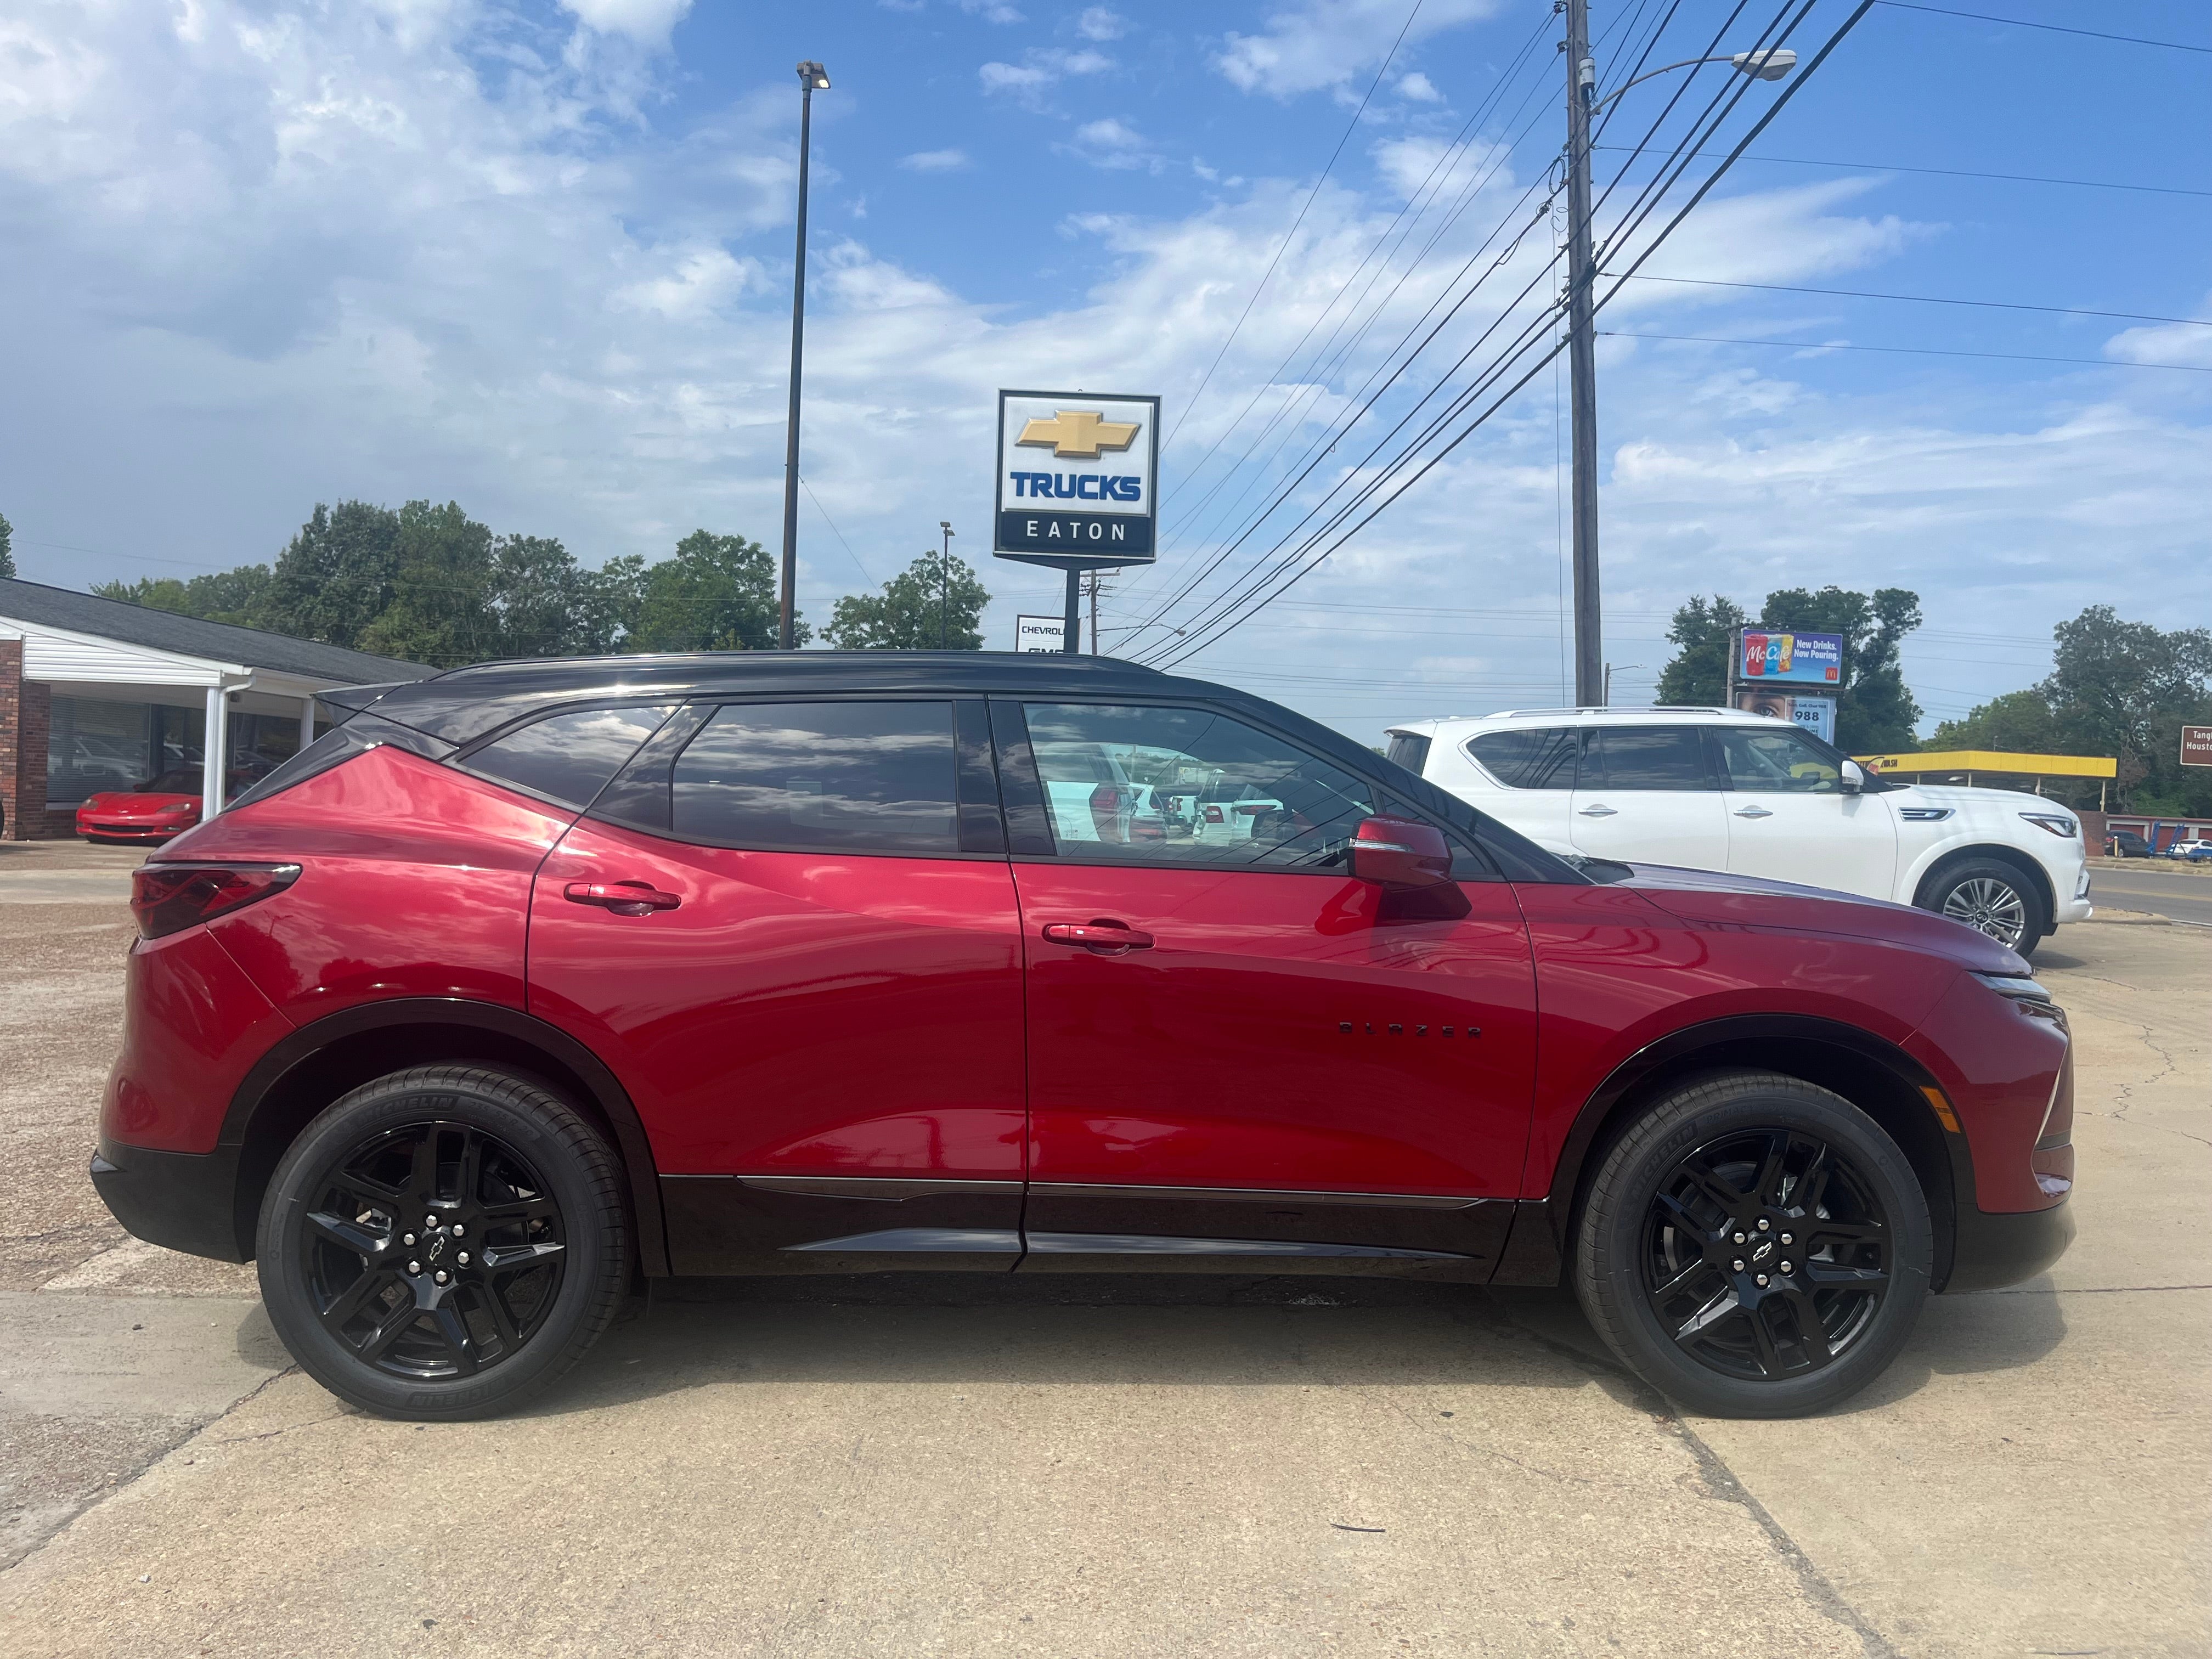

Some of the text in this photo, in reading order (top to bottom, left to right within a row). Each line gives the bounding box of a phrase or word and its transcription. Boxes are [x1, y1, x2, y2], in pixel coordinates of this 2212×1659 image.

[1010, 471, 1141, 501] TRUCKS
[1026, 520, 1125, 540] EATON
[1022, 626, 1064, 635] CHEVROL
[1797, 640, 1837, 650] New Drinks.
[1794, 649, 1838, 662] Now Pouring.
[1795, 711, 1819, 721] 988
[1340, 1022, 1480, 1038] BLAZER
[1631, 1125, 1694, 1200] MICHELIN
